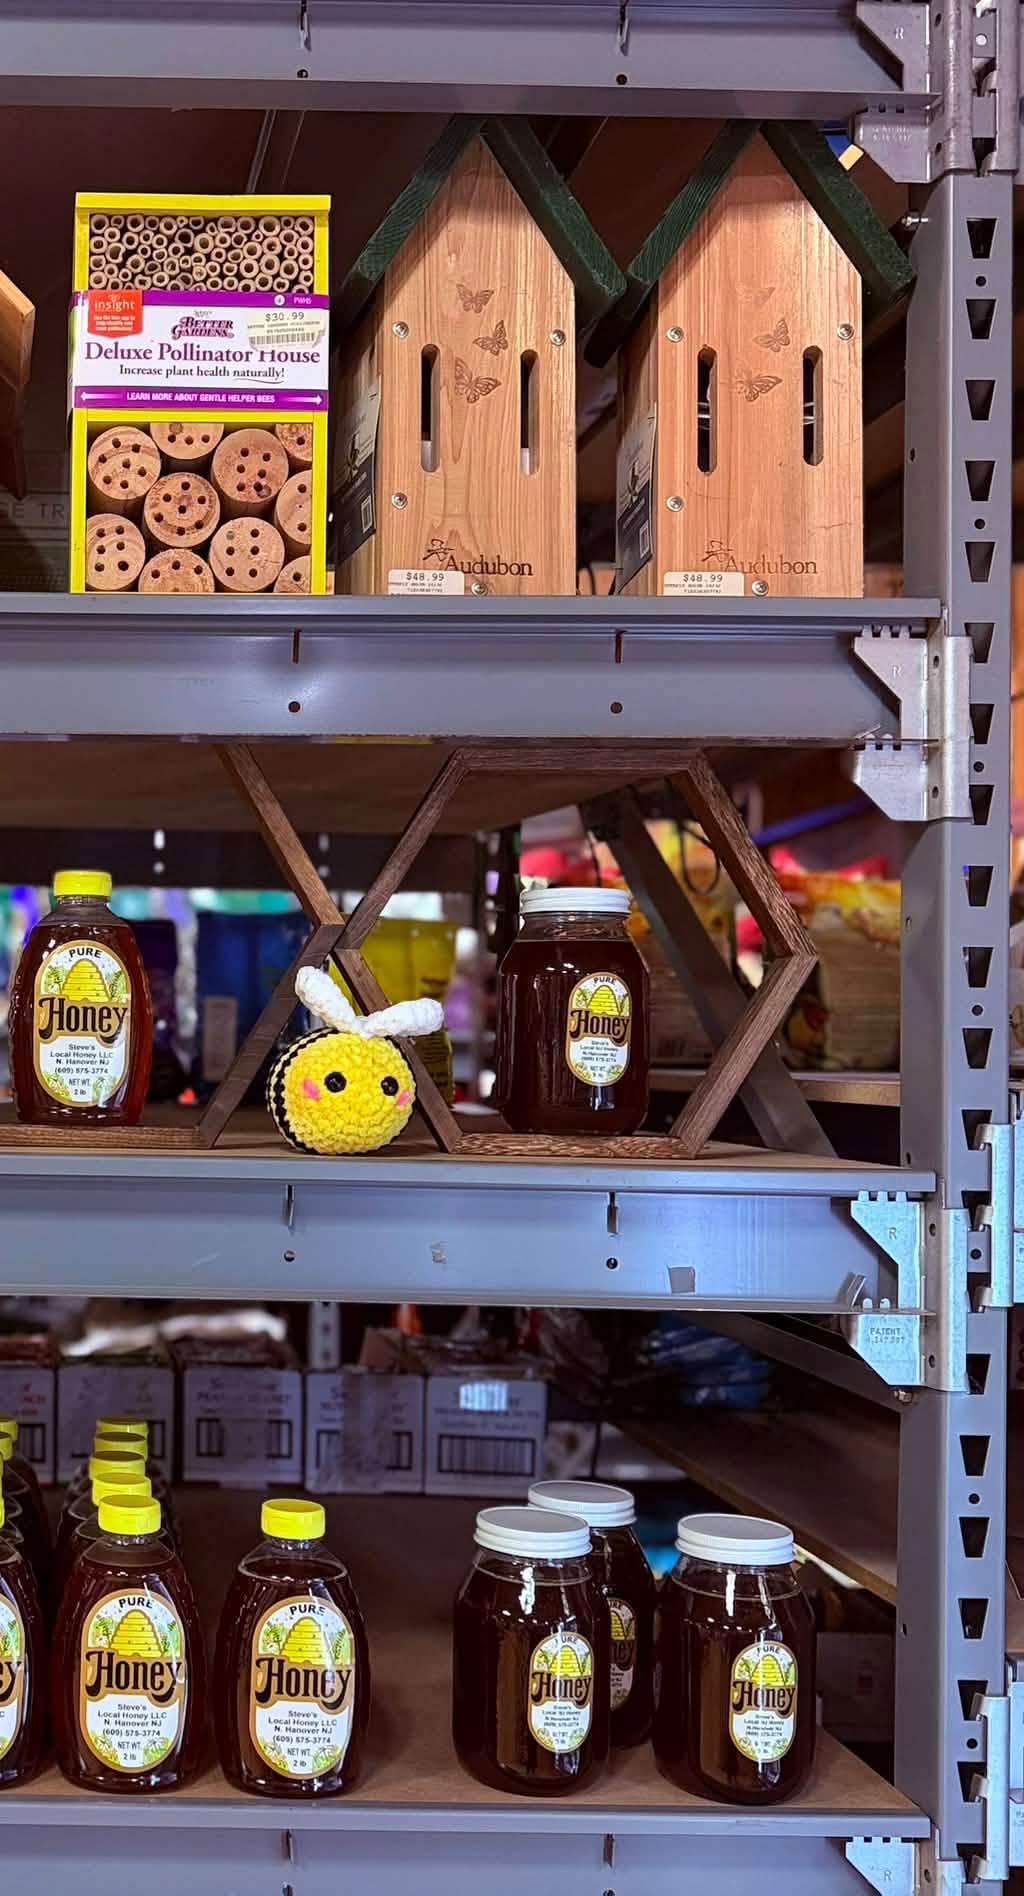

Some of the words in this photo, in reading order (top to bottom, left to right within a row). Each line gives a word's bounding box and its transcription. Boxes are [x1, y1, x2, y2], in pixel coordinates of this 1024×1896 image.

[94, 300, 136, 312] insight
[265, 311, 305, 322] $30.99
[84, 341, 153, 360] Deluxe
[158, 341, 253, 363] Pollinator
[257, 348, 321, 364] House
[119, 364, 163, 375] Increase
[165, 365, 194, 378] plant
[196, 365, 230, 377] health
[232, 367, 285, 380] naturally!
[126, 391, 151, 401] LEARN
[152, 392, 173, 401] MORE
[174, 392, 198, 402] ABOUT
[199, 393, 226, 402] GENTLE
[228, 394, 256, 403] HELPER
[257, 394, 276, 403] BEES
[444, 554, 534, 576] Audubon
[724, 553, 818, 575] Audubon
[406, 571, 445, 582] $48.99
[682, 573, 724, 583] $48.99
[69, 947, 102, 959] PURE
[38, 996, 129, 1044] Honey
[569, 1009, 630, 1044] Honey
[68, 1043, 95, 1051] Steve's
[72, 1051, 97, 1059] Honey
[98, 1051, 114, 1059] LLC
[68, 1078, 80, 1086] NET
[888, 1227, 898, 1239] R
[118, 1596, 153, 1609] PURE
[85, 1650, 183, 1703] Honey
[255, 1656, 352, 1710] Honey
[117, 1703, 147, 1711] Steve's
[97, 1709, 120, 1718] Local
[122, 1711, 148, 1720] Honey
[150, 1711, 167, 1719] LLC
[288, 1710, 318, 1719] Steve's
[114, 1719, 149, 1727] Hanover
[268, 1716, 291, 1725] Local
[292, 1718, 319, 1727] Honey
[321, 1718, 338, 1726] LLC
[102, 1728, 123, 1737] (609)
[285, 1726, 320, 1735] Hanover
[117, 1741, 130, 1749] NET
[272, 1735, 294, 1745] (609)
[287, 1747, 299, 1756] NET
[883, 1870, 893, 1881] R
